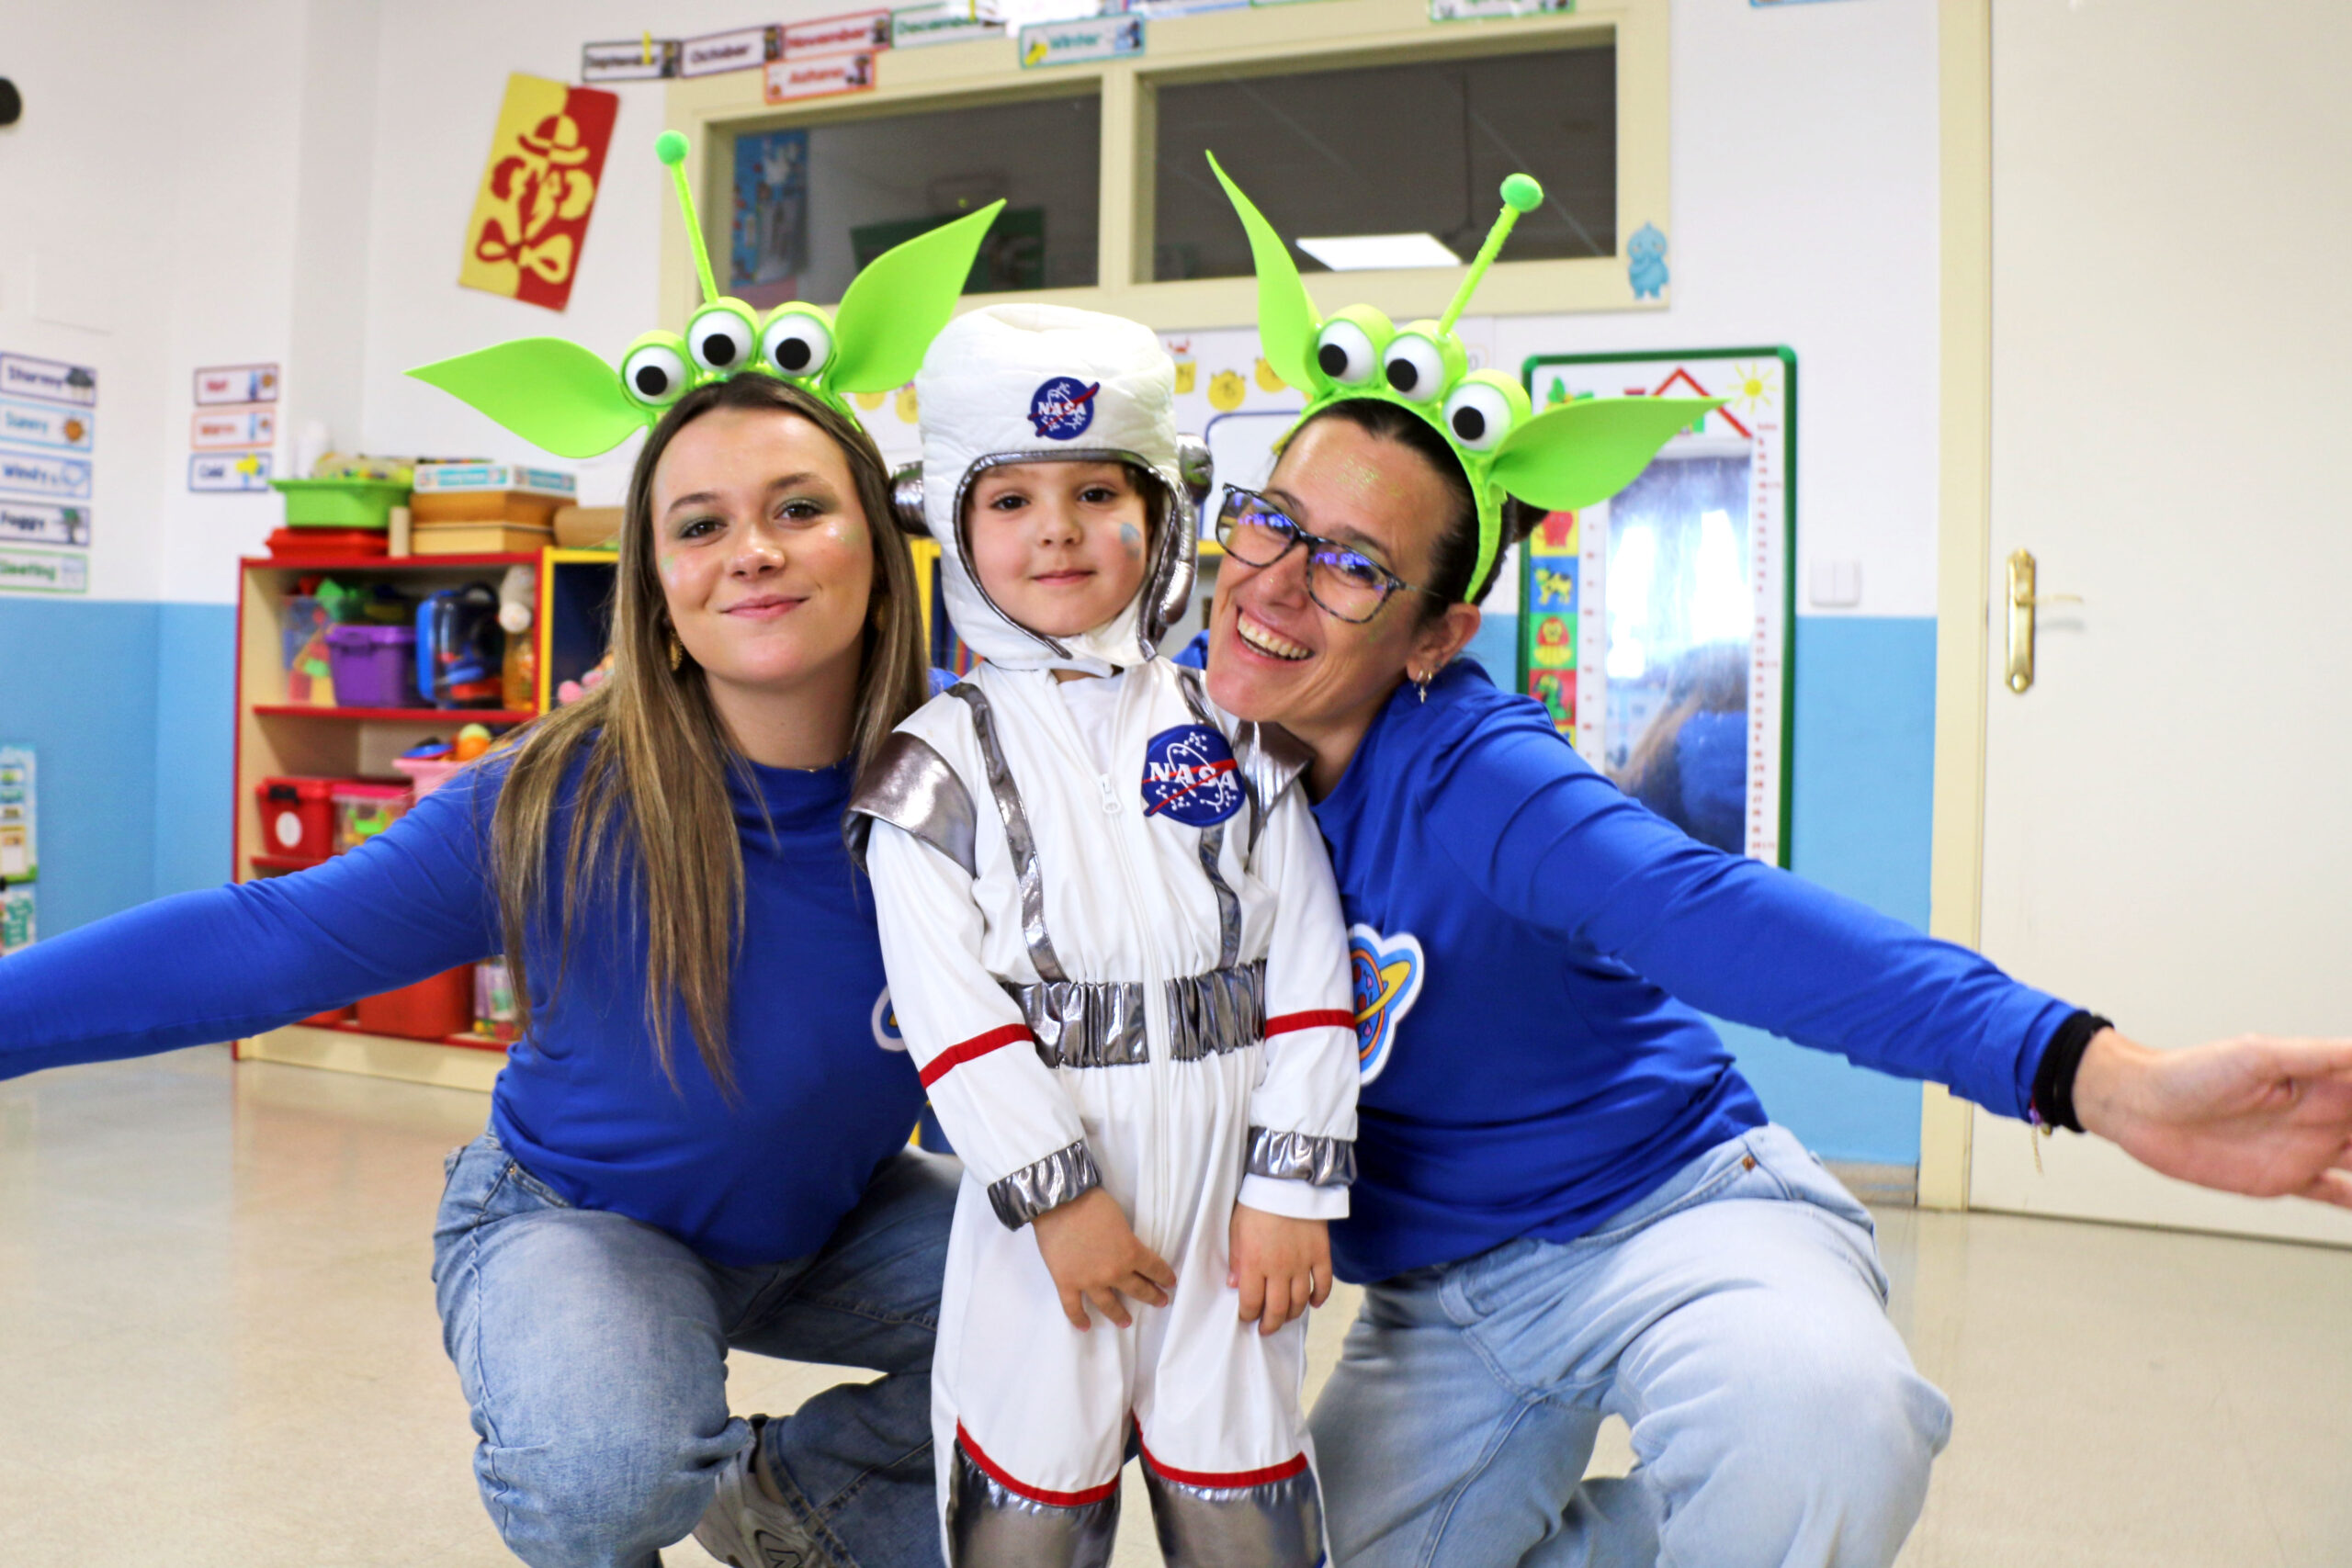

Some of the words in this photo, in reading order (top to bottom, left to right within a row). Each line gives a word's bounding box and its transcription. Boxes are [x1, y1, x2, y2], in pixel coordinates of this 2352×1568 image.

[585, 52, 657, 70] Septembr
[1038, 401, 1087, 416] NASA
[1148, 761, 1239, 791] NASA
